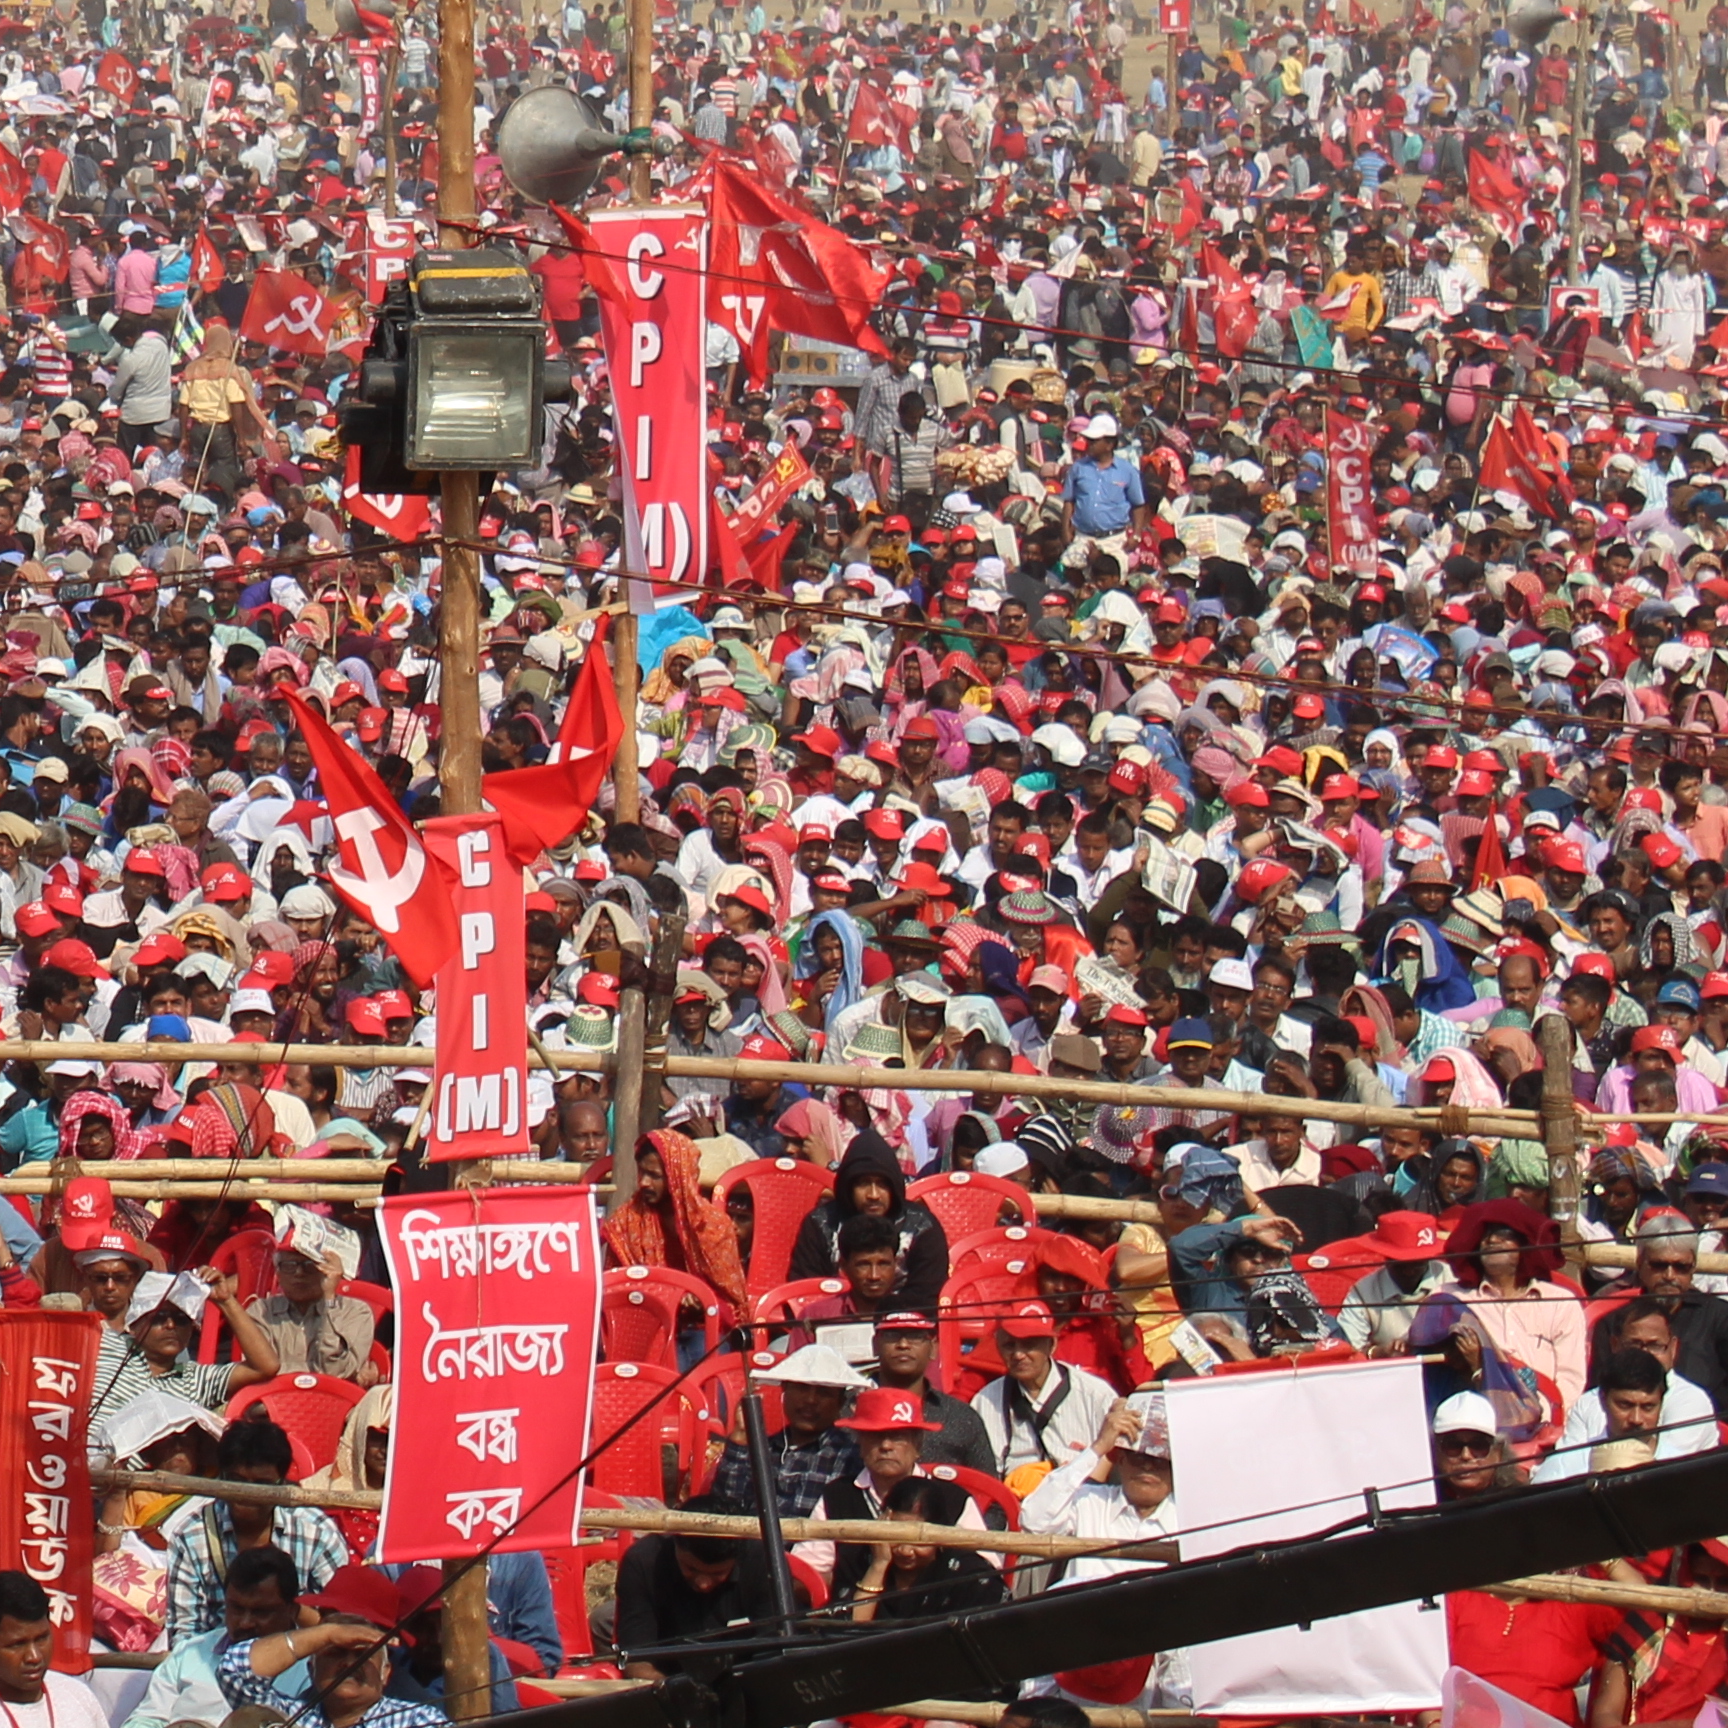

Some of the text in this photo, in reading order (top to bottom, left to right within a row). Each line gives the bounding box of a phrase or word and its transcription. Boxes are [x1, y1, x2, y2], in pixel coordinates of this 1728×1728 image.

[436, 829, 521, 1142] CPI(M)
[455, 1408, 520, 1464] বন্ধ
[445, 1487, 523, 1540] কর
